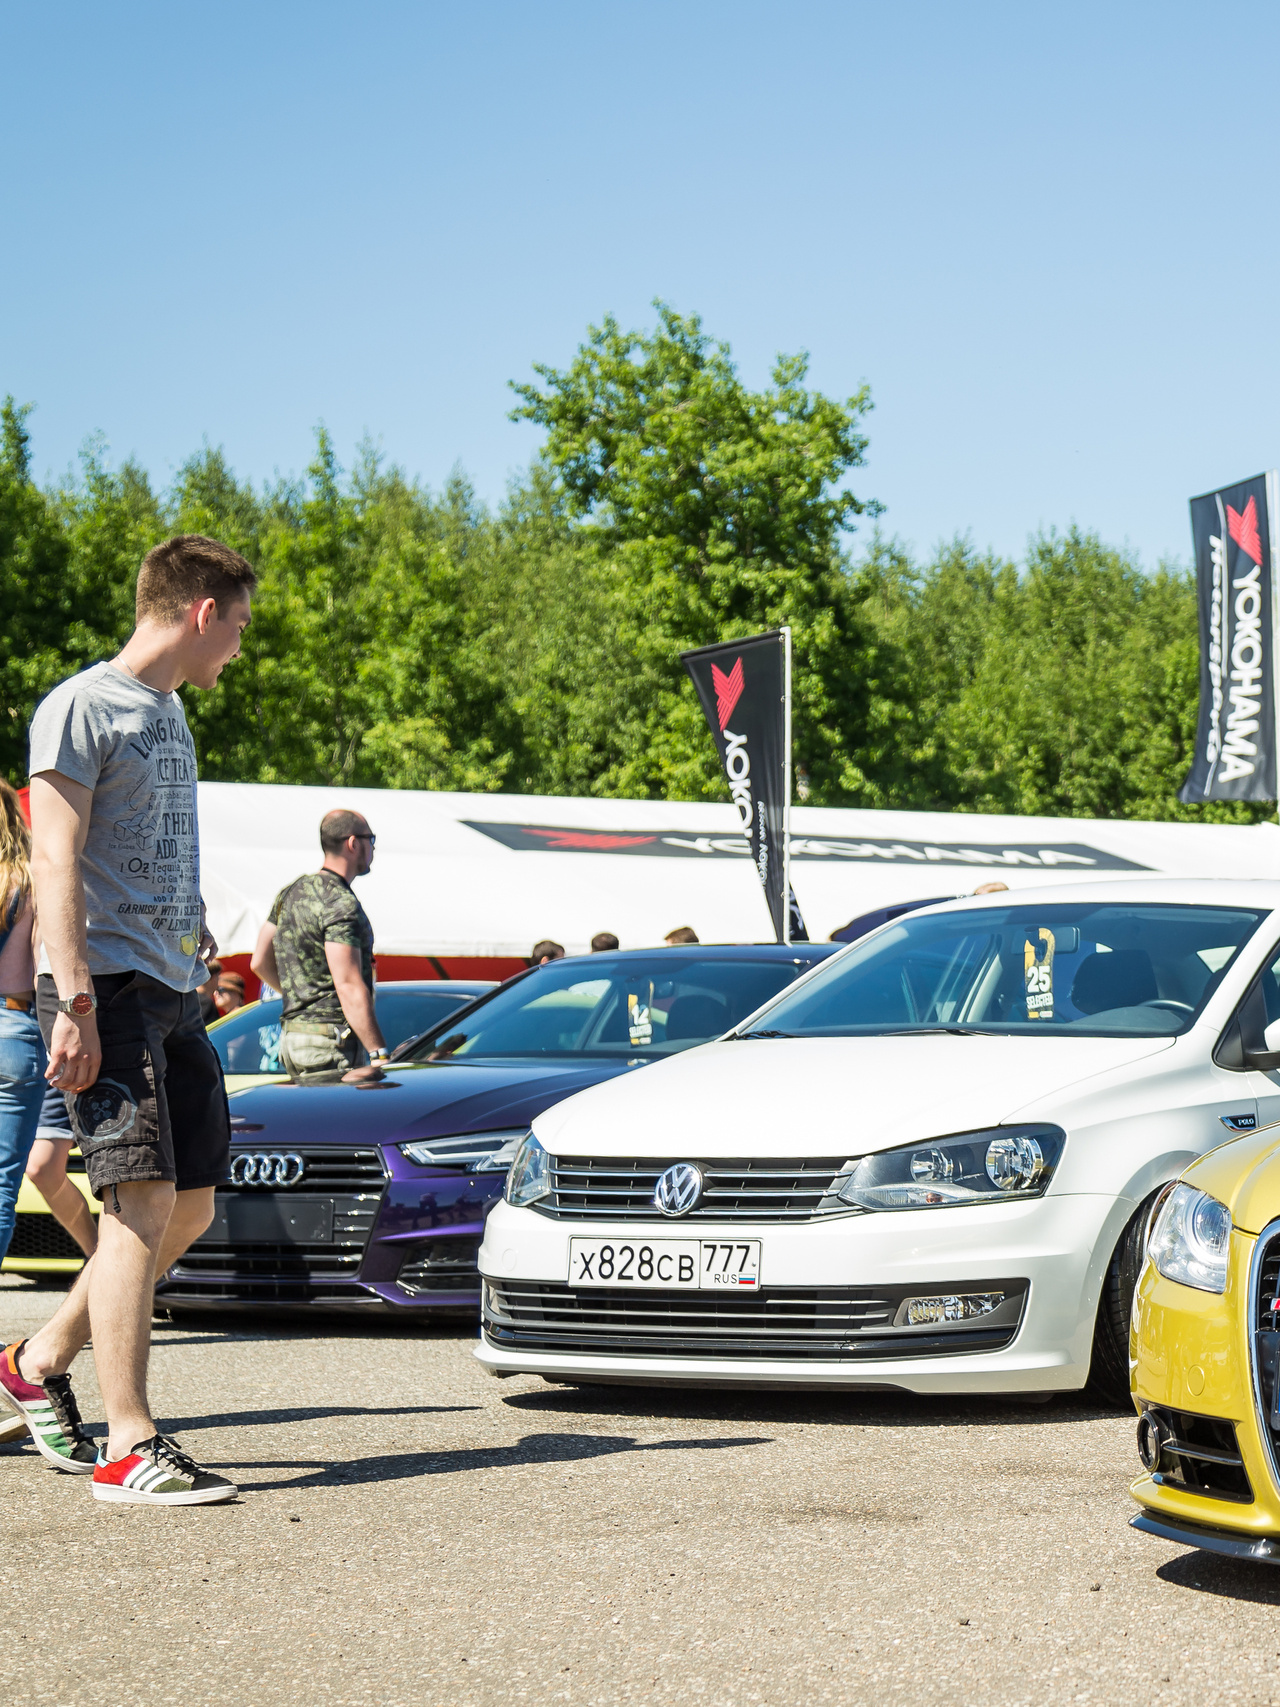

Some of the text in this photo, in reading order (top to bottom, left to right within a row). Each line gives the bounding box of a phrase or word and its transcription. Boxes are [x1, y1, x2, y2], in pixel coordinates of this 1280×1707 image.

[1218, 565, 1262, 783] YOKOHAMA
[130, 718, 167, 760] LONG
[155, 758, 170, 782] ICE
[170, 757, 189, 782] TEA
[161, 812, 194, 836] THEN
[154, 838, 178, 860] ADD
[151, 861, 180, 875] Tequila
[117, 903, 158, 916] GARNISH
[160, 905, 180, 917] WITH
[184, 905, 199, 917] SLICE
[151, 917, 190, 932] OF LEMON
[1027, 966, 1051, 993] 25
[703, 1243, 751, 1273] 777
[714, 1273, 738, 1284] RUS
